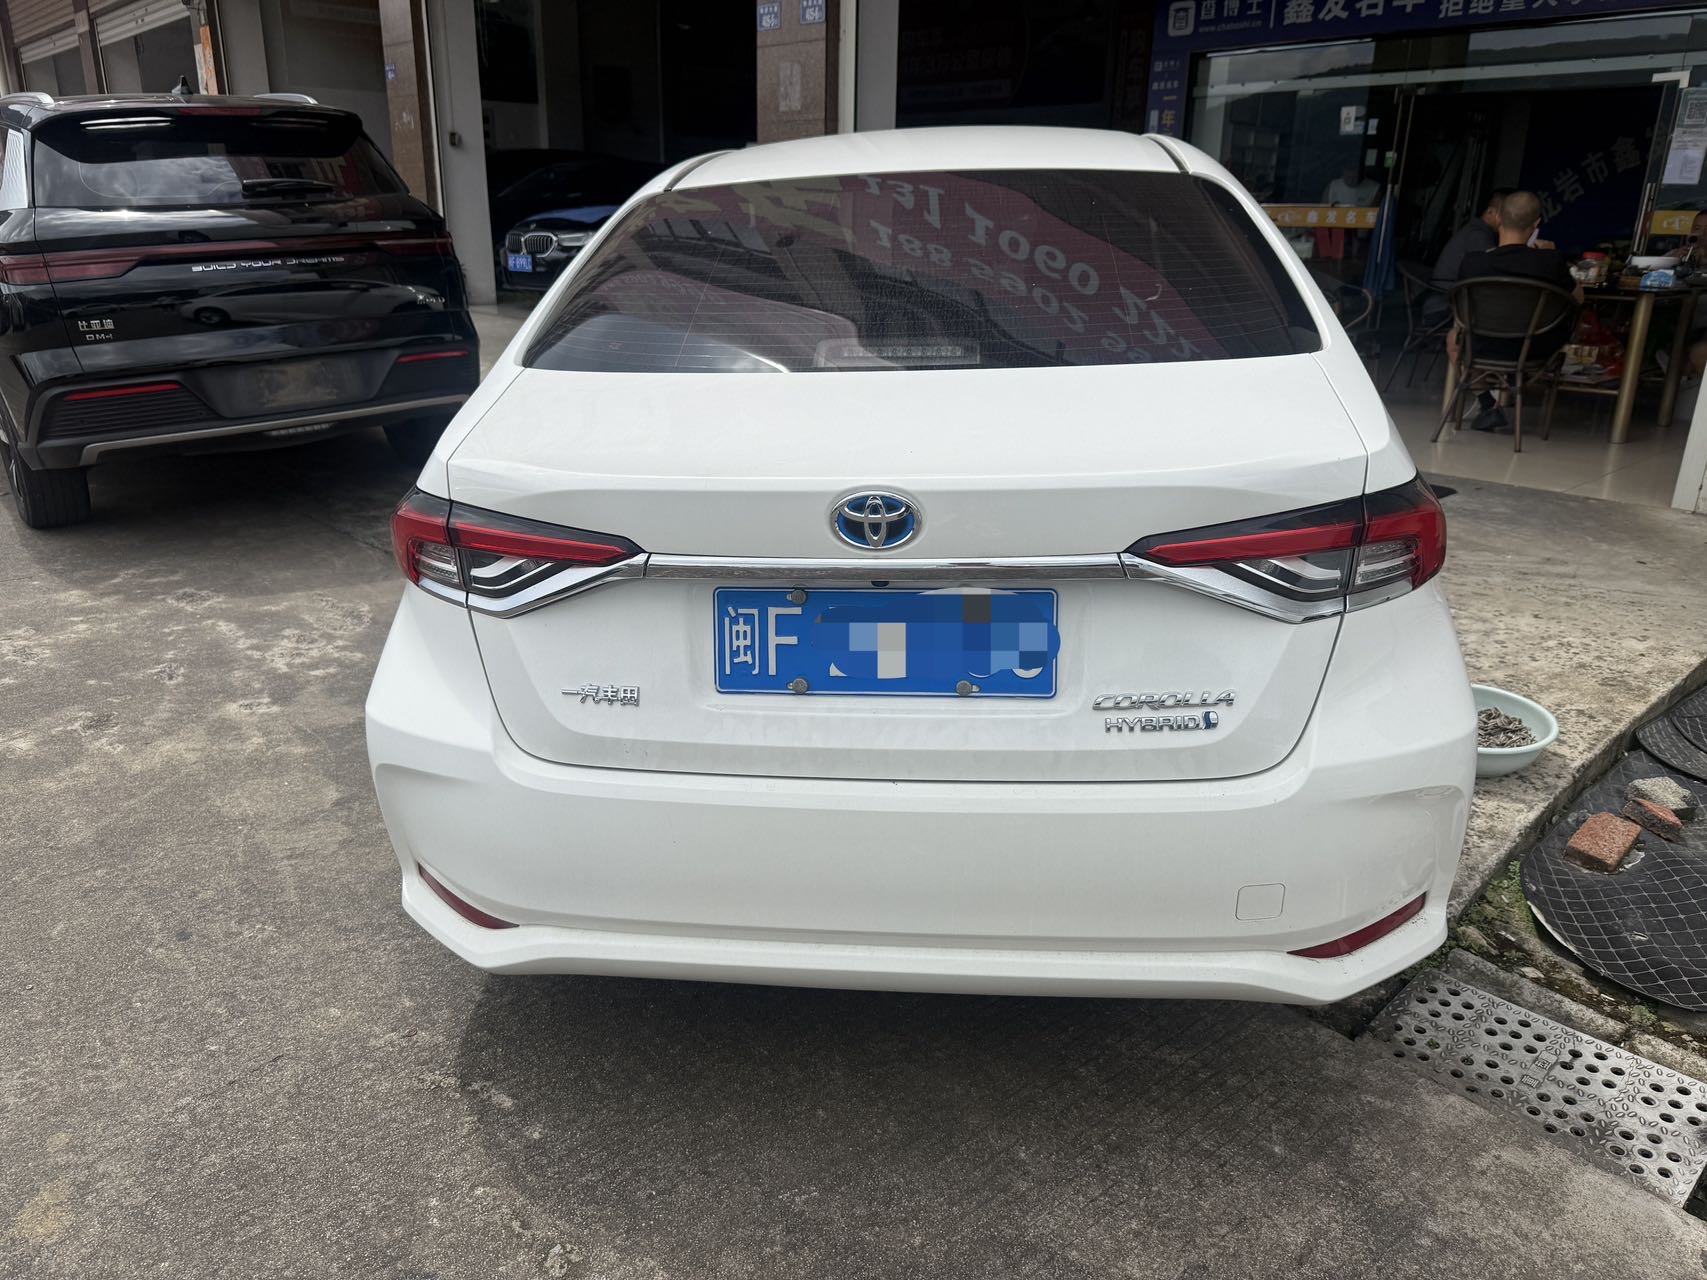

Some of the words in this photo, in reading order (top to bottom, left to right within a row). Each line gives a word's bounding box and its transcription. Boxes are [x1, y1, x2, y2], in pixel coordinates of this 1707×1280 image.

[191, 263, 237, 272] BUILD
[240, 259, 282, 268] YOUR
[78, 319, 115, 331] 比亚迪
[561, 684, 640, 706] 一汽丰田
[1092, 690, 1236, 710] COROLLA
[1105, 714, 1201, 733] HYBRID
